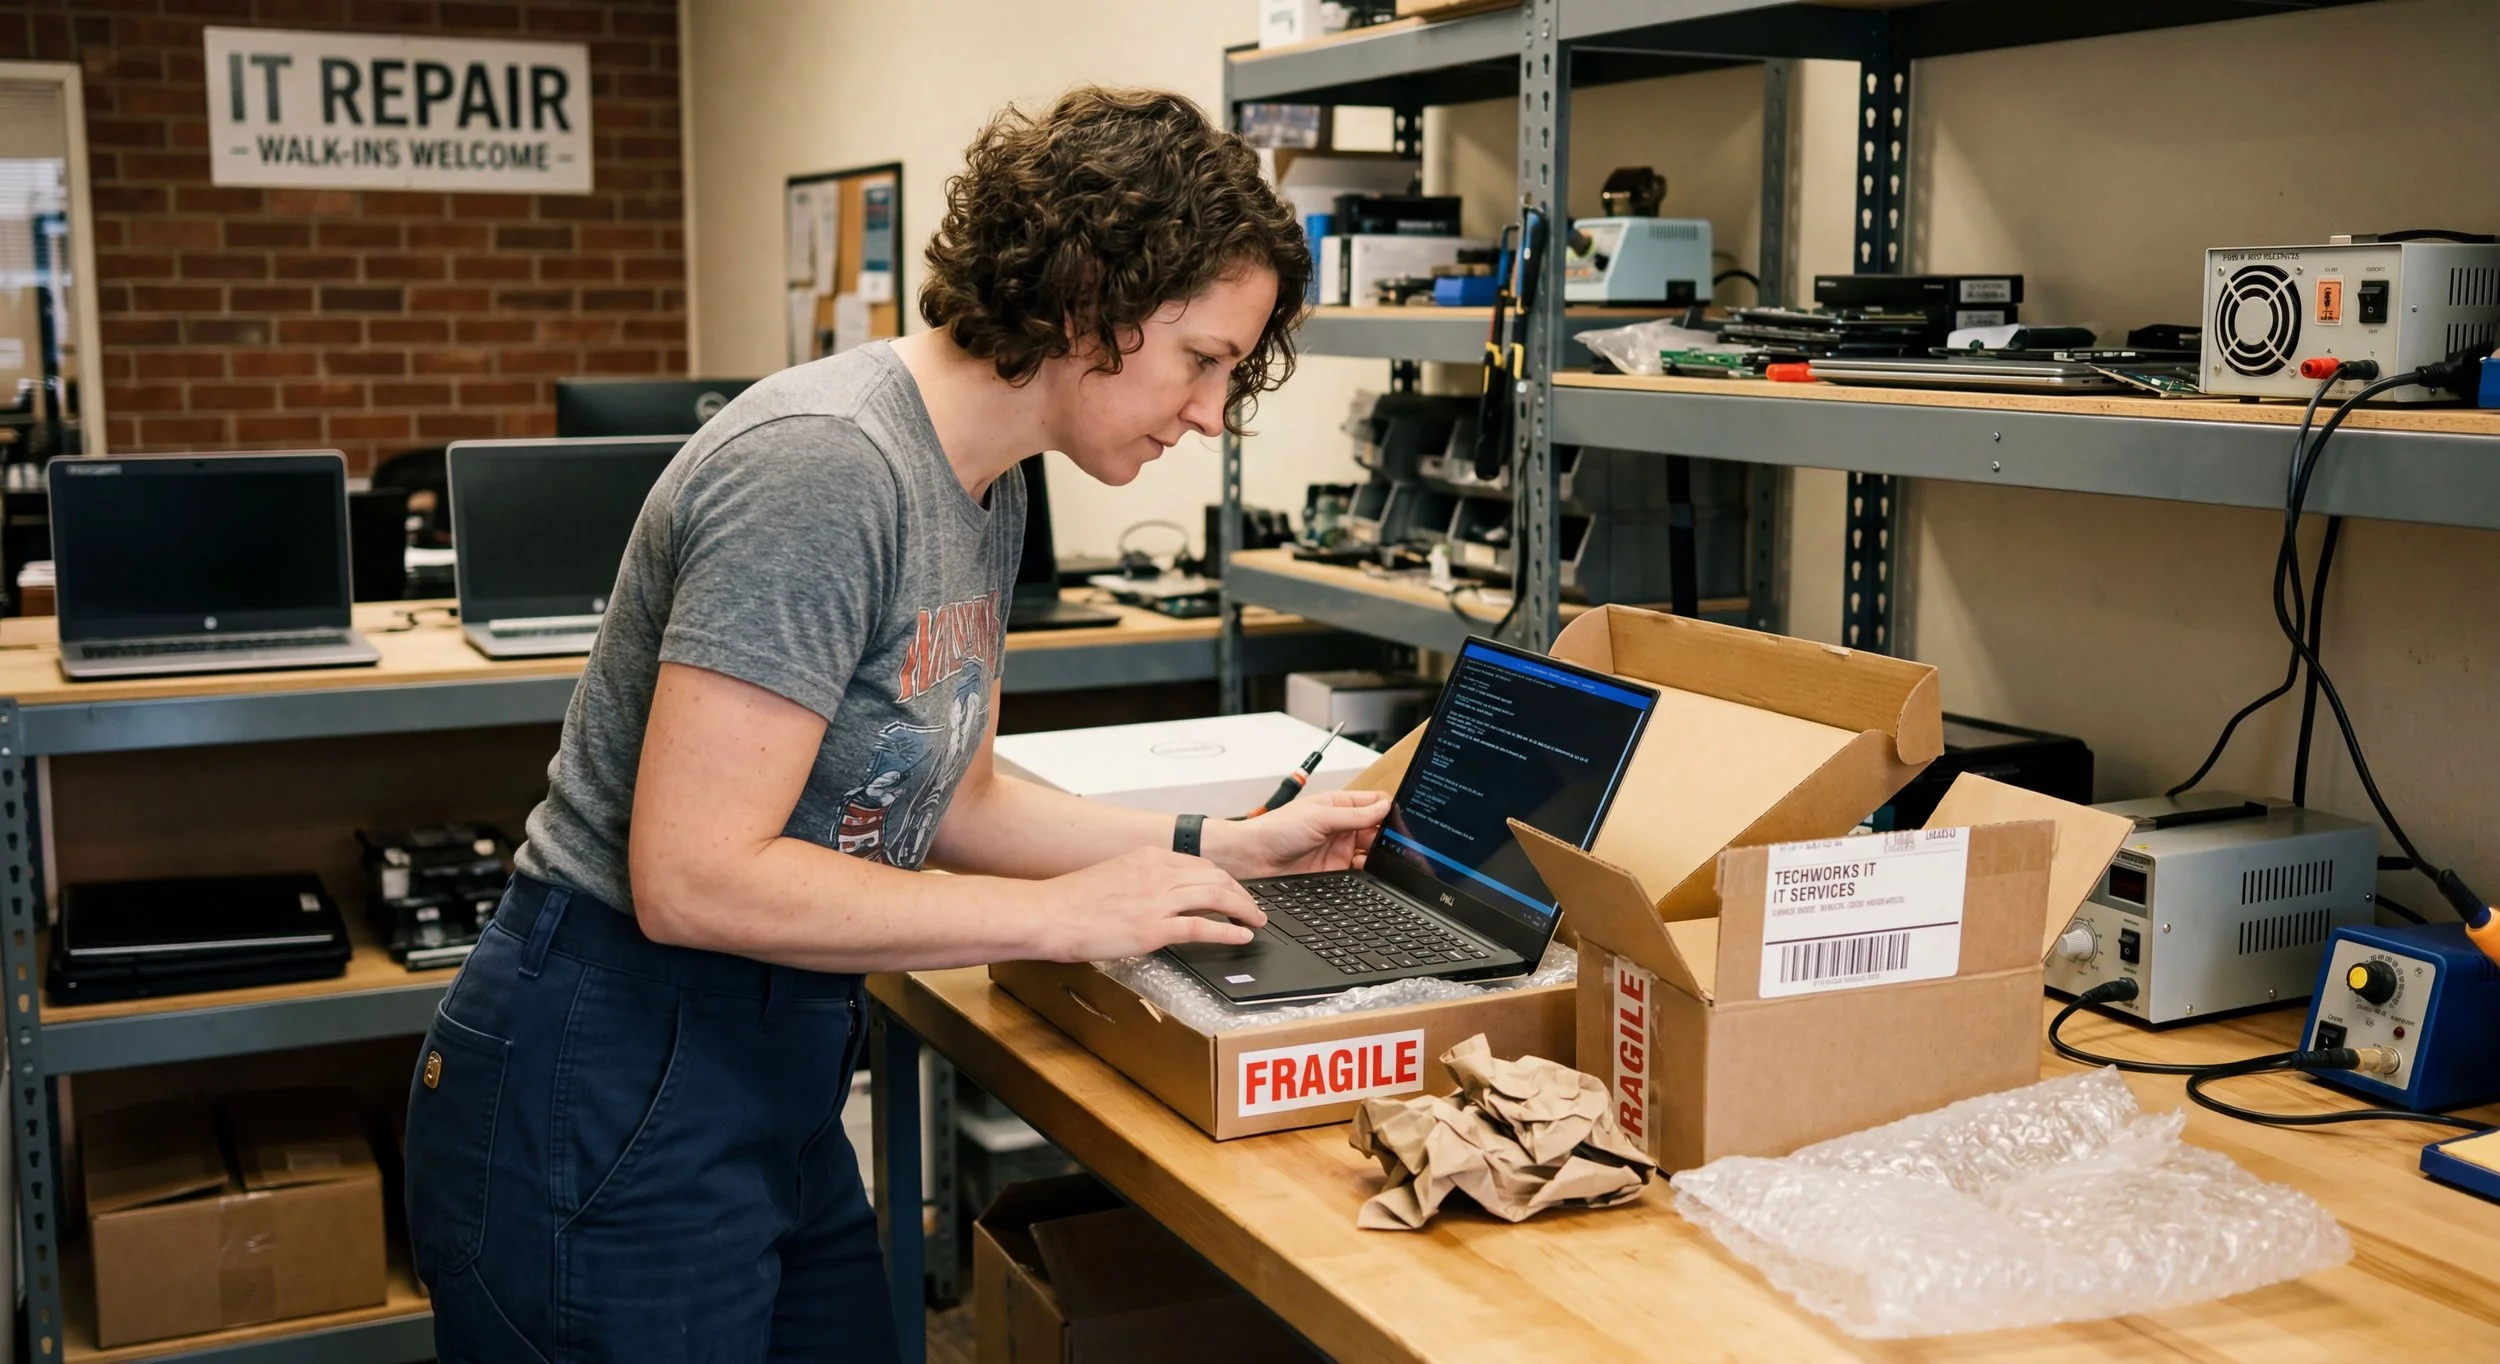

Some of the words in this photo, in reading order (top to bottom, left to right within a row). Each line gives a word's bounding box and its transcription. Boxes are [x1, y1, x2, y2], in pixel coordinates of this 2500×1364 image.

[229, 53, 292, 123] IT
[320, 57, 572, 132] REPAIR
[257, 135, 400, 168] WALK-INS
[409, 138, 549, 171] WELCOME
[1773, 890, 1785, 903] IT
[1790, 883, 1855, 902] SERVICES
[1775, 864, 1859, 885] TECHWORKS
[1864, 863, 1876, 877] IT
[1246, 1039, 1417, 1105] FRAGILE
[1618, 969, 1644, 1146] RAGILE
